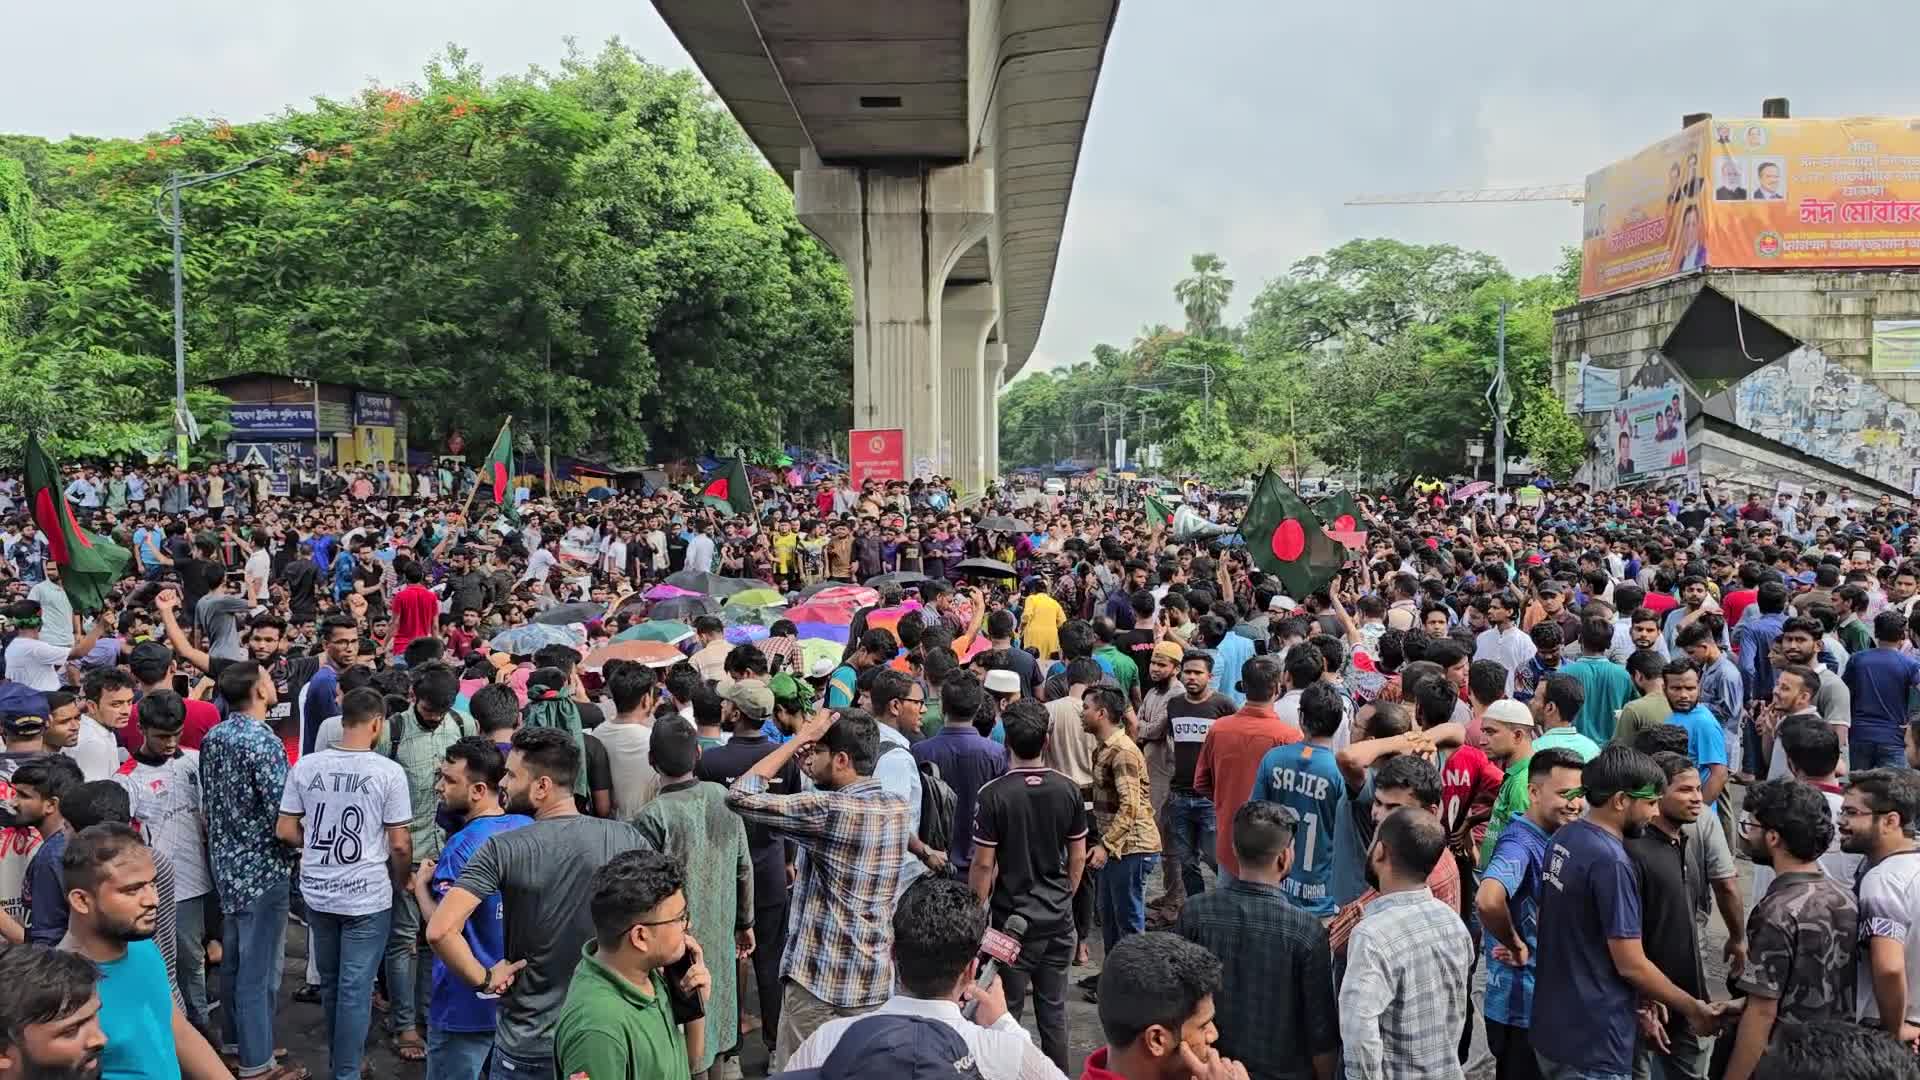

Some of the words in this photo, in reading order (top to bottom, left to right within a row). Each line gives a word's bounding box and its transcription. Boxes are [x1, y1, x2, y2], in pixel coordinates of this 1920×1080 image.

[1800, 198, 1836, 224] ঈদ
[307, 772, 374, 795] ATIK
[1272, 766, 1330, 801] SAJIB
[311, 802, 365, 865] 48
